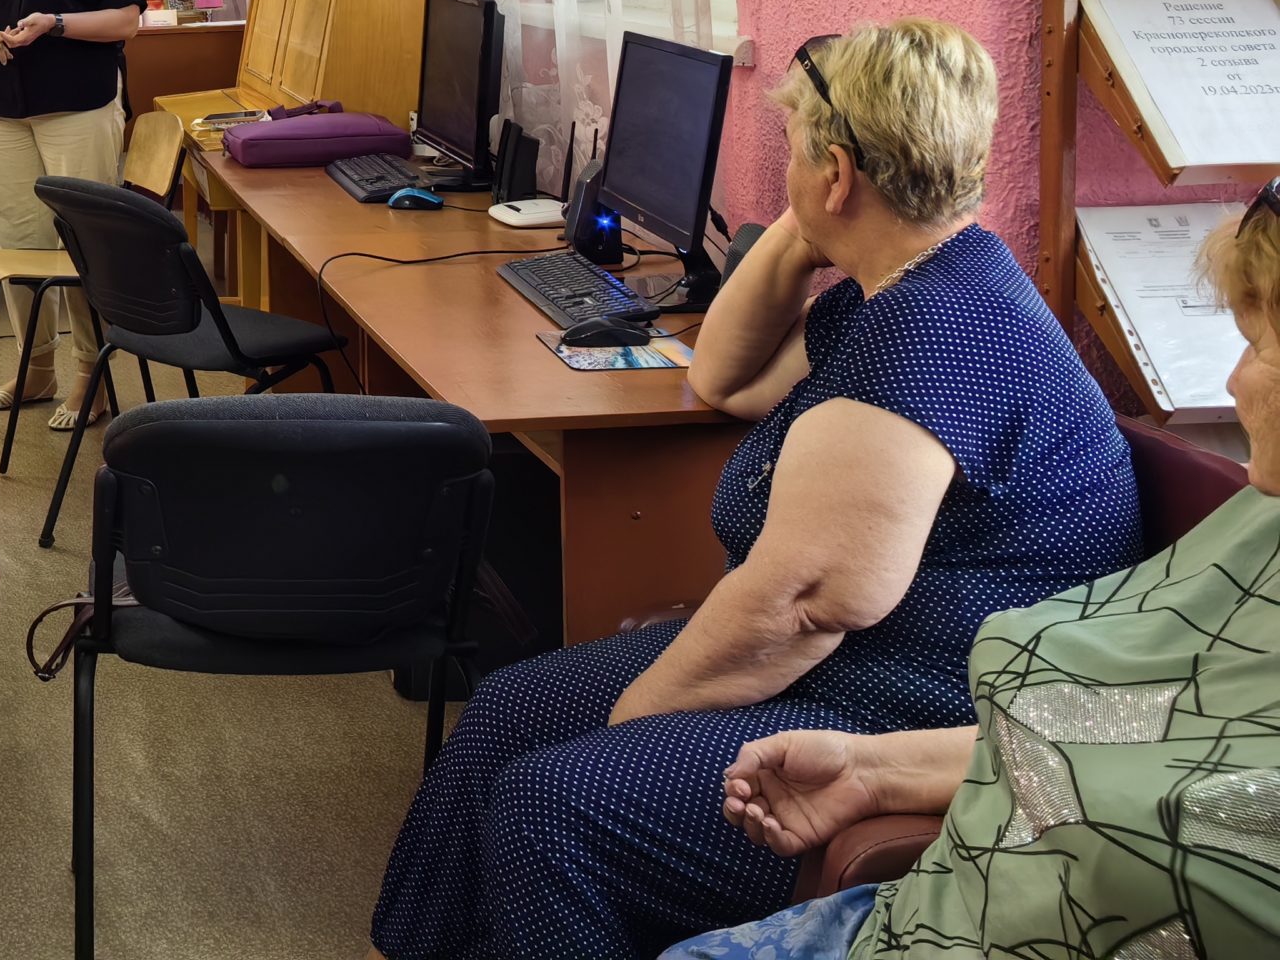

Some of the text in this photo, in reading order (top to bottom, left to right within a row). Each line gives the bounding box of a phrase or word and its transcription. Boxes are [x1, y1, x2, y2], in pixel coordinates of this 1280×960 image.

[1162, 1, 1224, 12] Решение
[1167, 15, 1236, 25] 73 сессии
[1132, 28, 1277, 42] Красноперекопского
[1150, 42, 1276, 56] городского совета
[1197, 57, 1259, 67] 2 созыва
[1226, 73, 1242, 81] от
